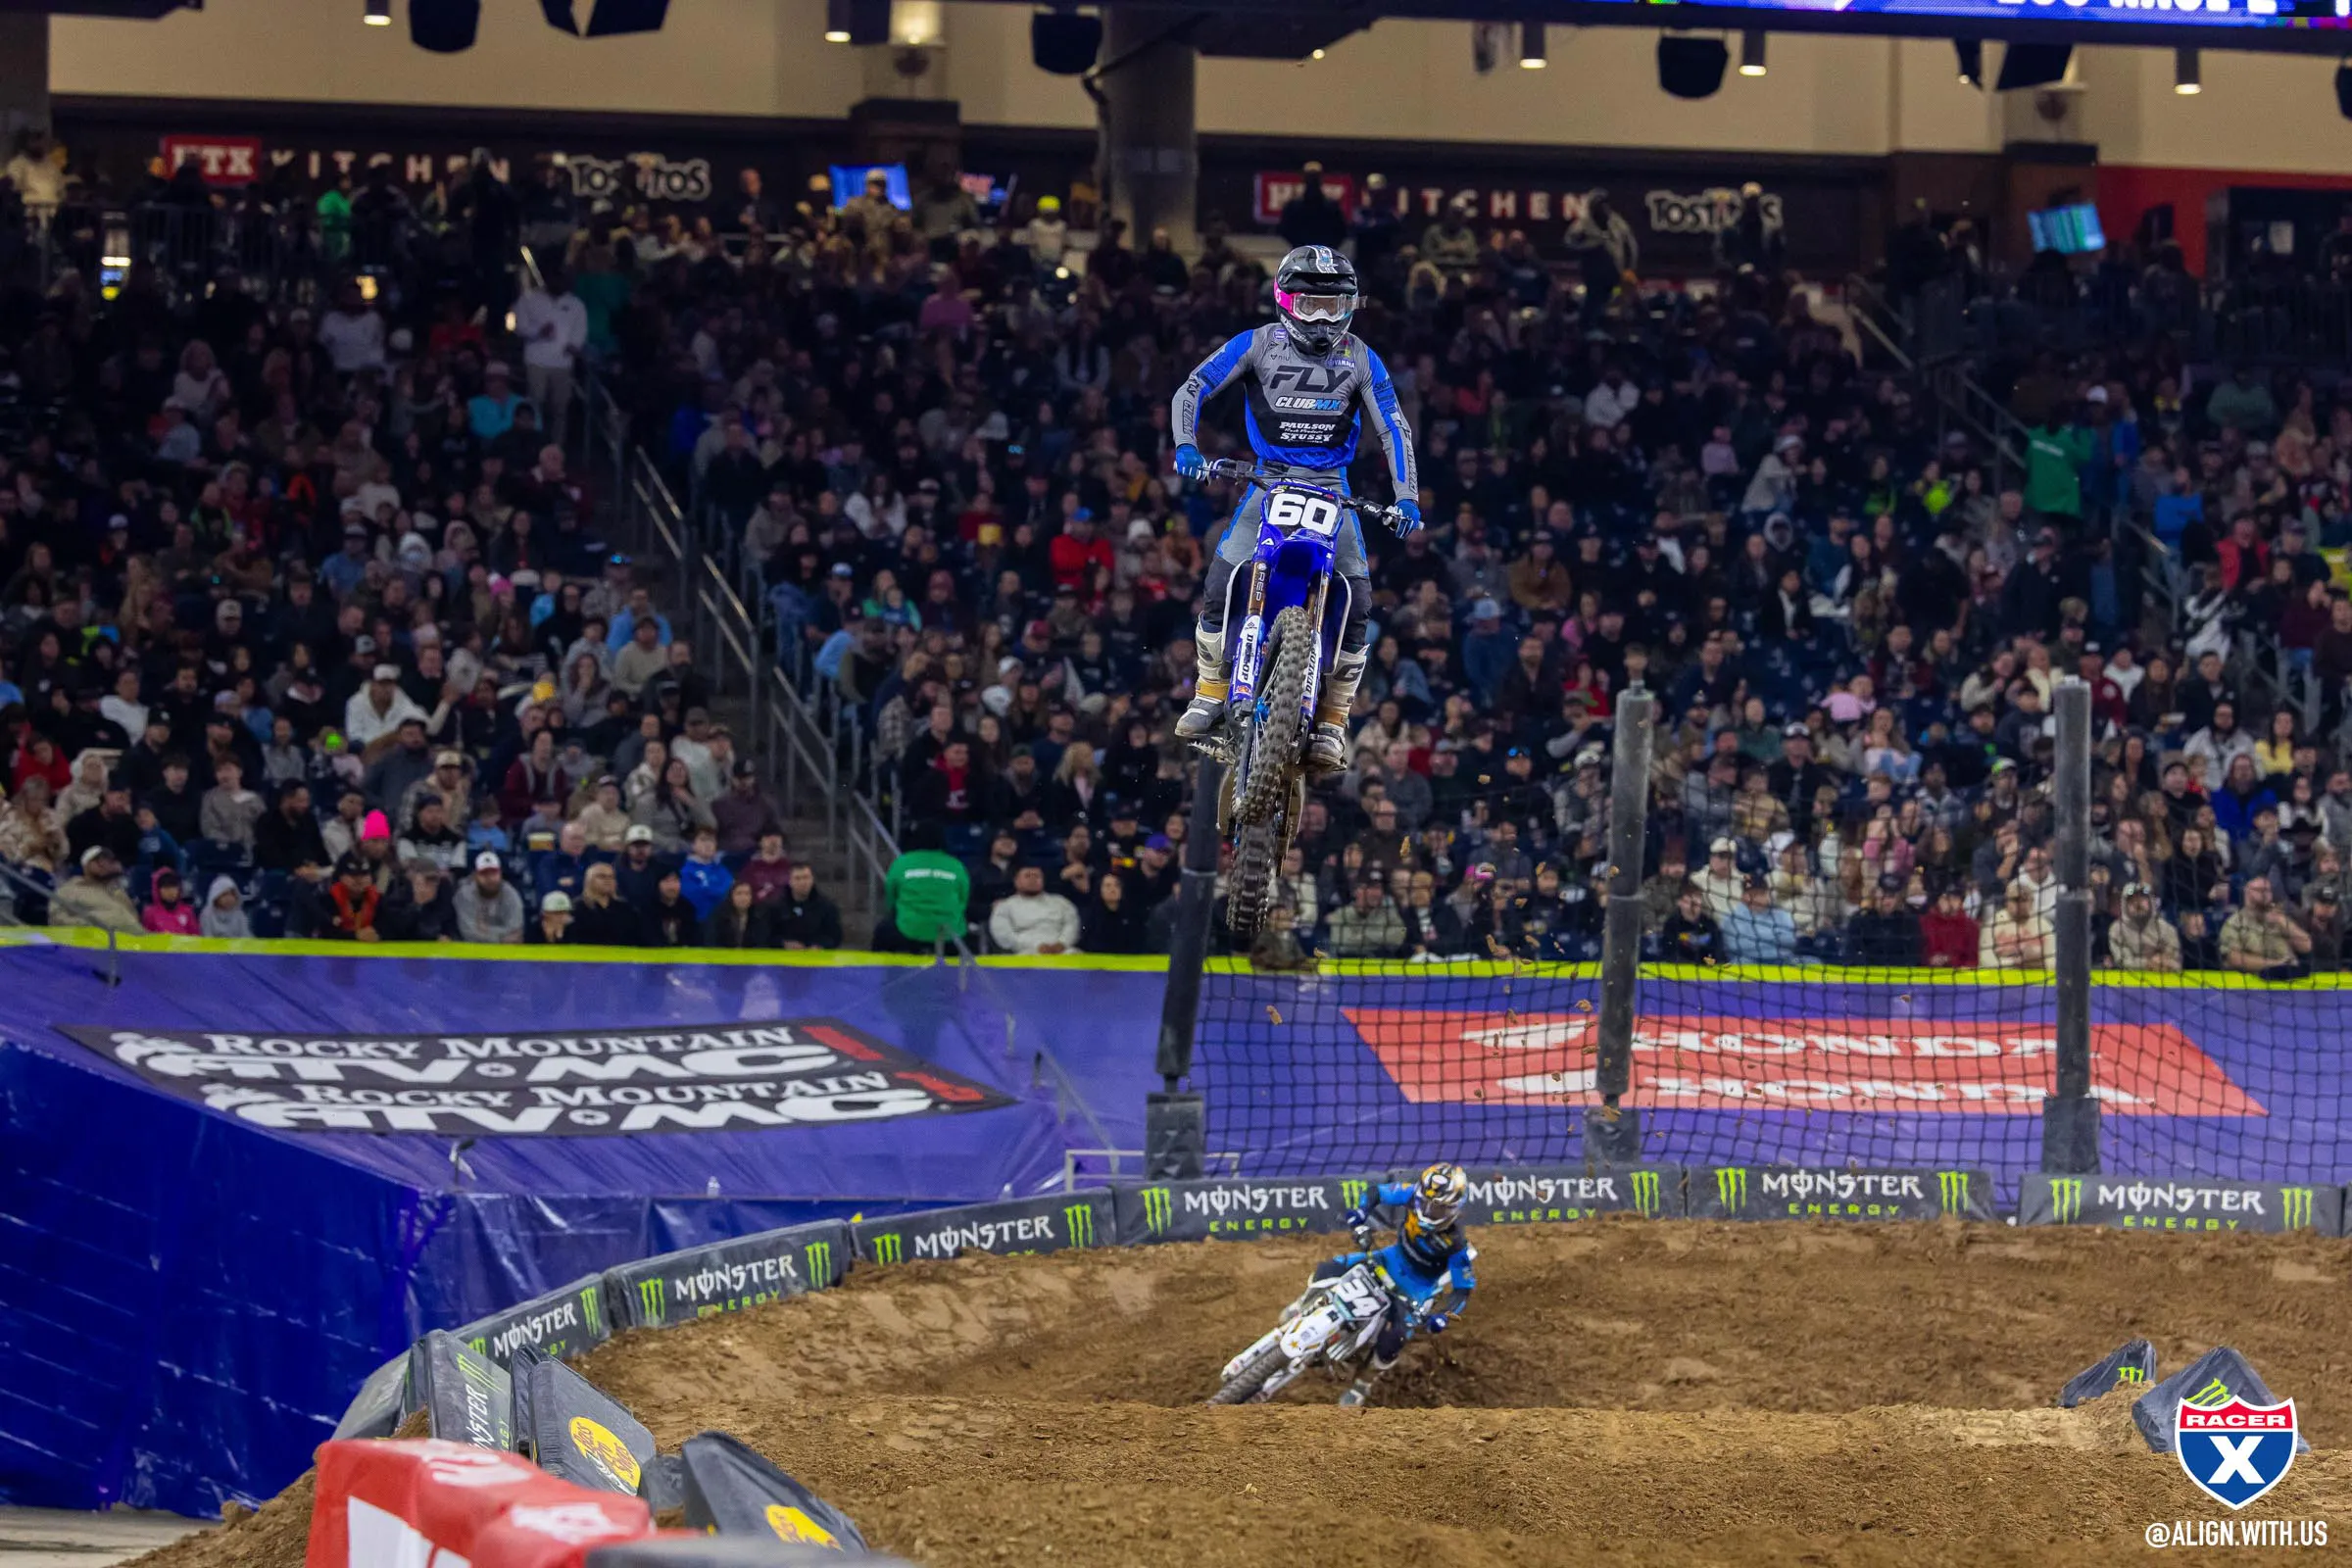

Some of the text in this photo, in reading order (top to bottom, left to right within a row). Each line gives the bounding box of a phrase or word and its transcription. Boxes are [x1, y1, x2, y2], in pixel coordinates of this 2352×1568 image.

[1270, 366, 1352, 393] FLY
[1275, 396, 1342, 411] CLUBMX
[1279, 421, 1336, 431] PAULSON
[1280, 432, 1334, 442] STUSSY
[1268, 493, 1339, 535] 60
[1255, 571, 1265, 602] REP
[204, 1027, 795, 1059] ROCKY MOUNTAIN
[292, 1071, 891, 1107] ROCKY MOUNTAIN
[1493, 1208, 1596, 1222] ENERGY
[1788, 1202, 1899, 1216] ENERGY
[1209, 1217, 1308, 1233] ENERGY
[2124, 1214, 2239, 1231] ENERGY
